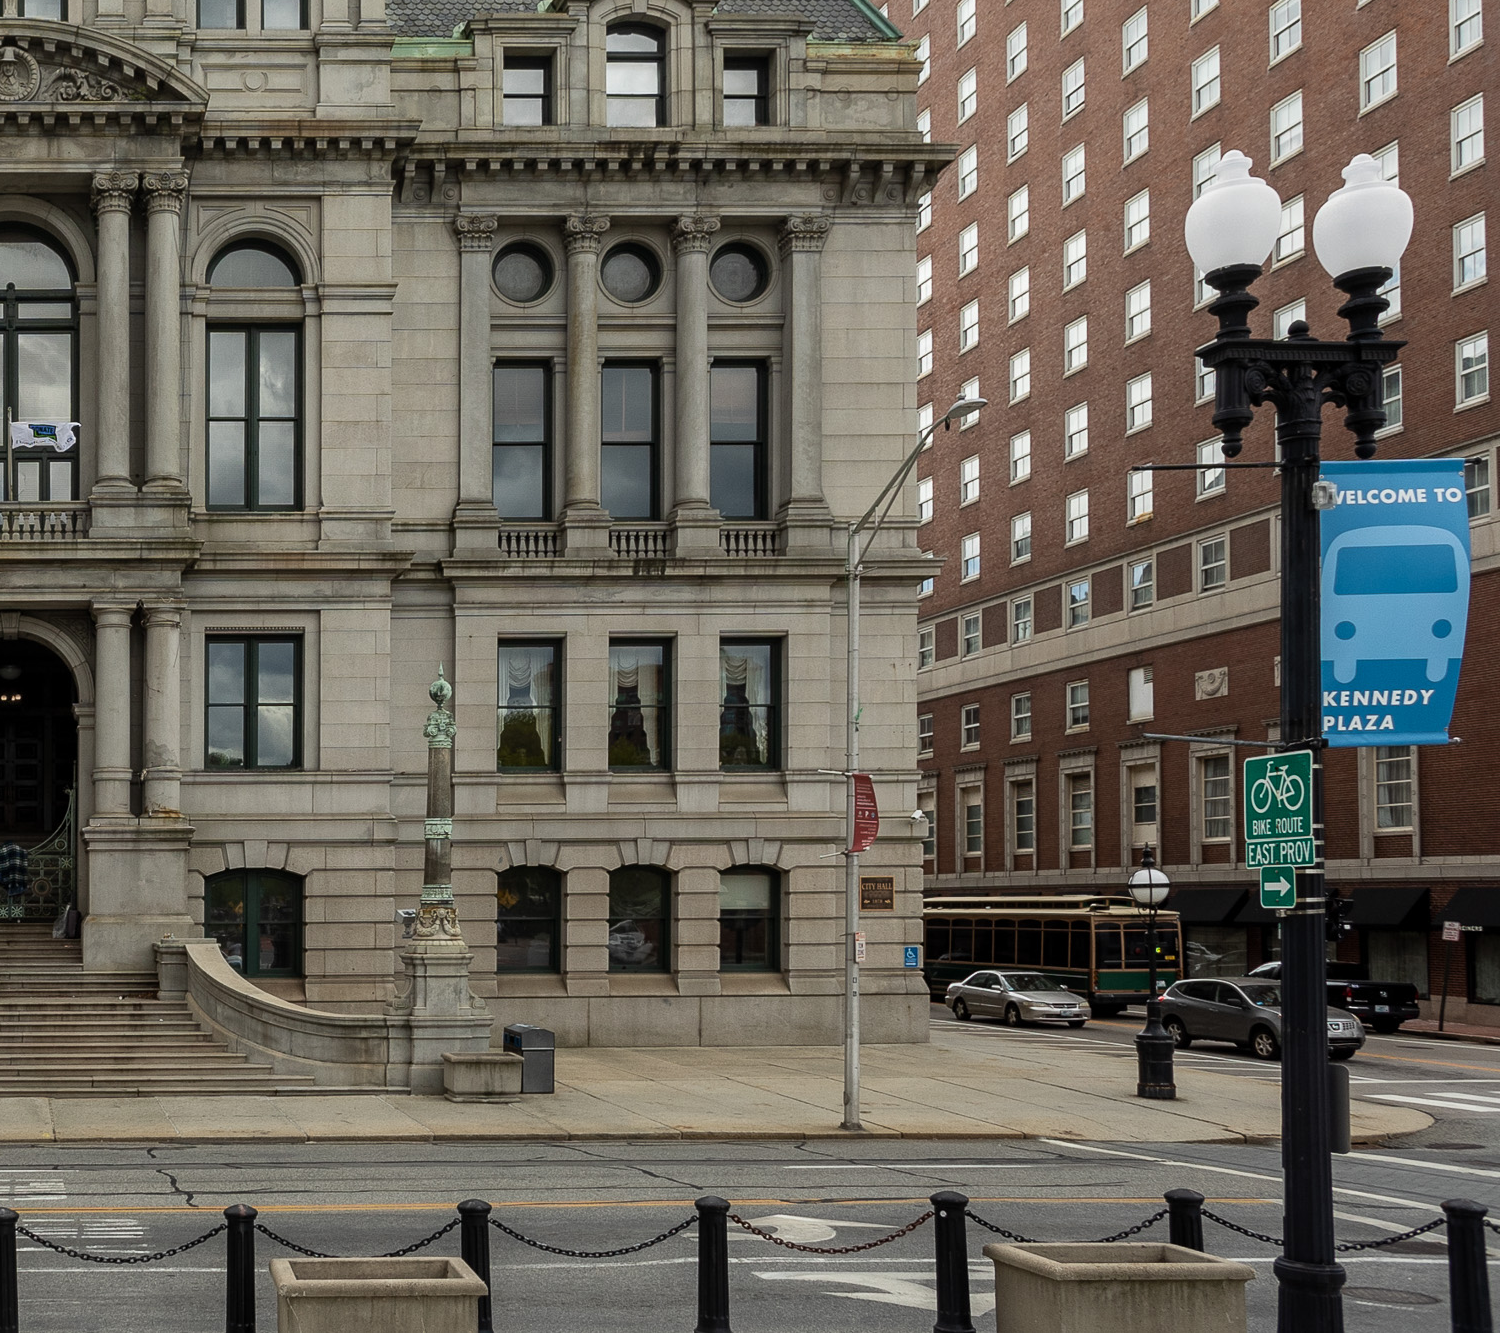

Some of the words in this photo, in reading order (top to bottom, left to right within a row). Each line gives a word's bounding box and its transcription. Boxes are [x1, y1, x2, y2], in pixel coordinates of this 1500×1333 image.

[1434, 488, 1463, 503] TO
[1323, 689, 1435, 707] KENNEDY
[1323, 715, 1394, 731] PLAZA
[1252, 819, 1272, 835] BIKE
[1276, 817, 1304, 834] ROUTE
[1249, 844, 1276, 865] EAST
[1280, 841, 1311, 863] PROV
[861, 883, 876, 891] CITY
